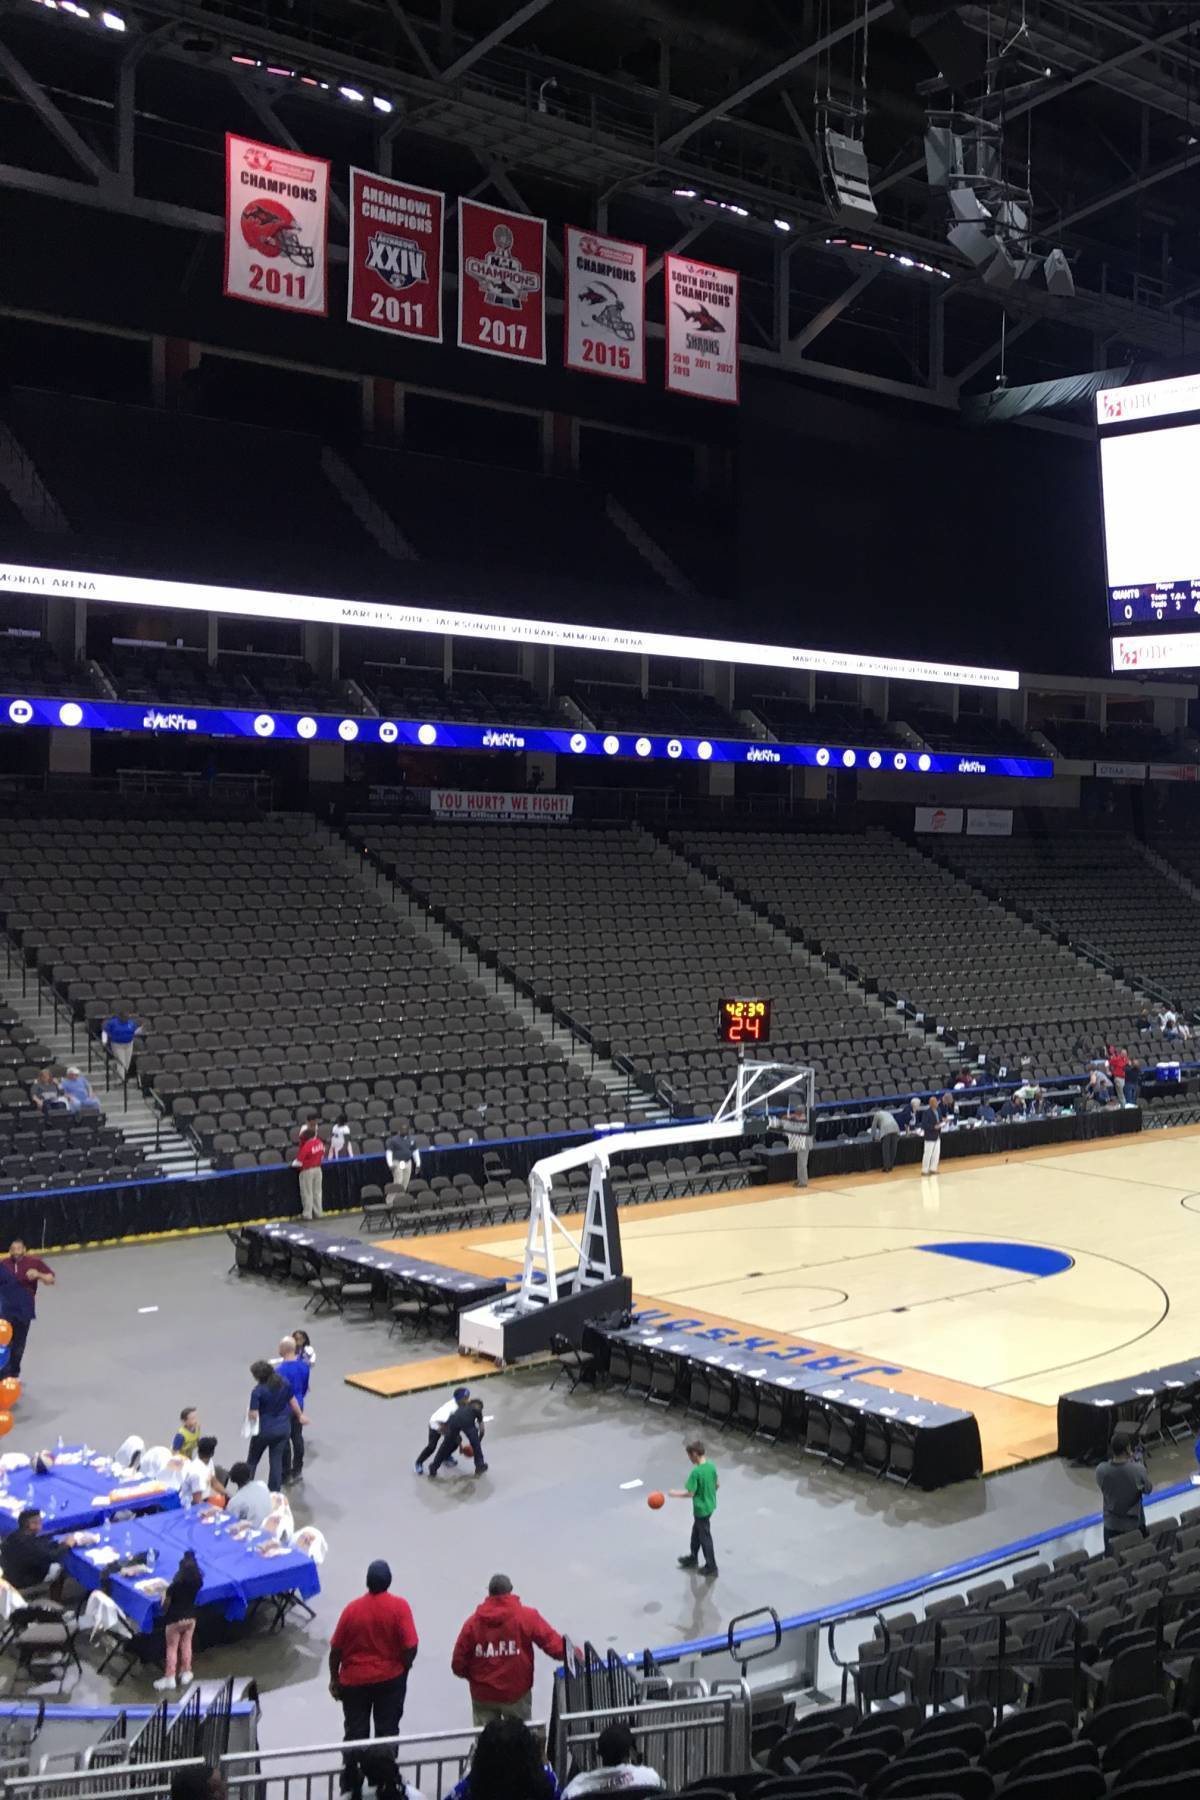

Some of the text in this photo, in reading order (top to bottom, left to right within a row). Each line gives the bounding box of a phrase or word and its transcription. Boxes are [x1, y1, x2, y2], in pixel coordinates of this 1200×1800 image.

[240, 171, 317, 203] CHAMPIONS
[362, 186, 432, 218] ARENABOWL
[362, 202, 432, 234] CHAMPIONS
[368, 241, 423, 279] XXIV
[576, 256, 636, 283] CHAMPIONS
[249, 264, 306, 300] 2011
[470, 261, 536, 287] CHAMPIONS
[672, 271, 734, 296] SOUTH DIVISION
[675, 283, 730, 308] CHAMPIONS
[370, 292, 423, 328] 2011
[479, 316, 527, 349] 2017
[582, 338, 630, 369] 2015
[52, 577, 97, 592] ARENA
[1112, 588, 1140, 601] GIANTS
[1124, 604, 1133, 620] 0
[1156, 608, 1163, 620] 0
[438, 793, 462, 809] YOU
[467, 794, 505, 810] HURT?
[511, 796, 529, 811] WE
[532, 797, 569, 812] FIGHT!
[726, 1002, 765, 1017] 42:39
[729, 1017, 759, 1040] 24
